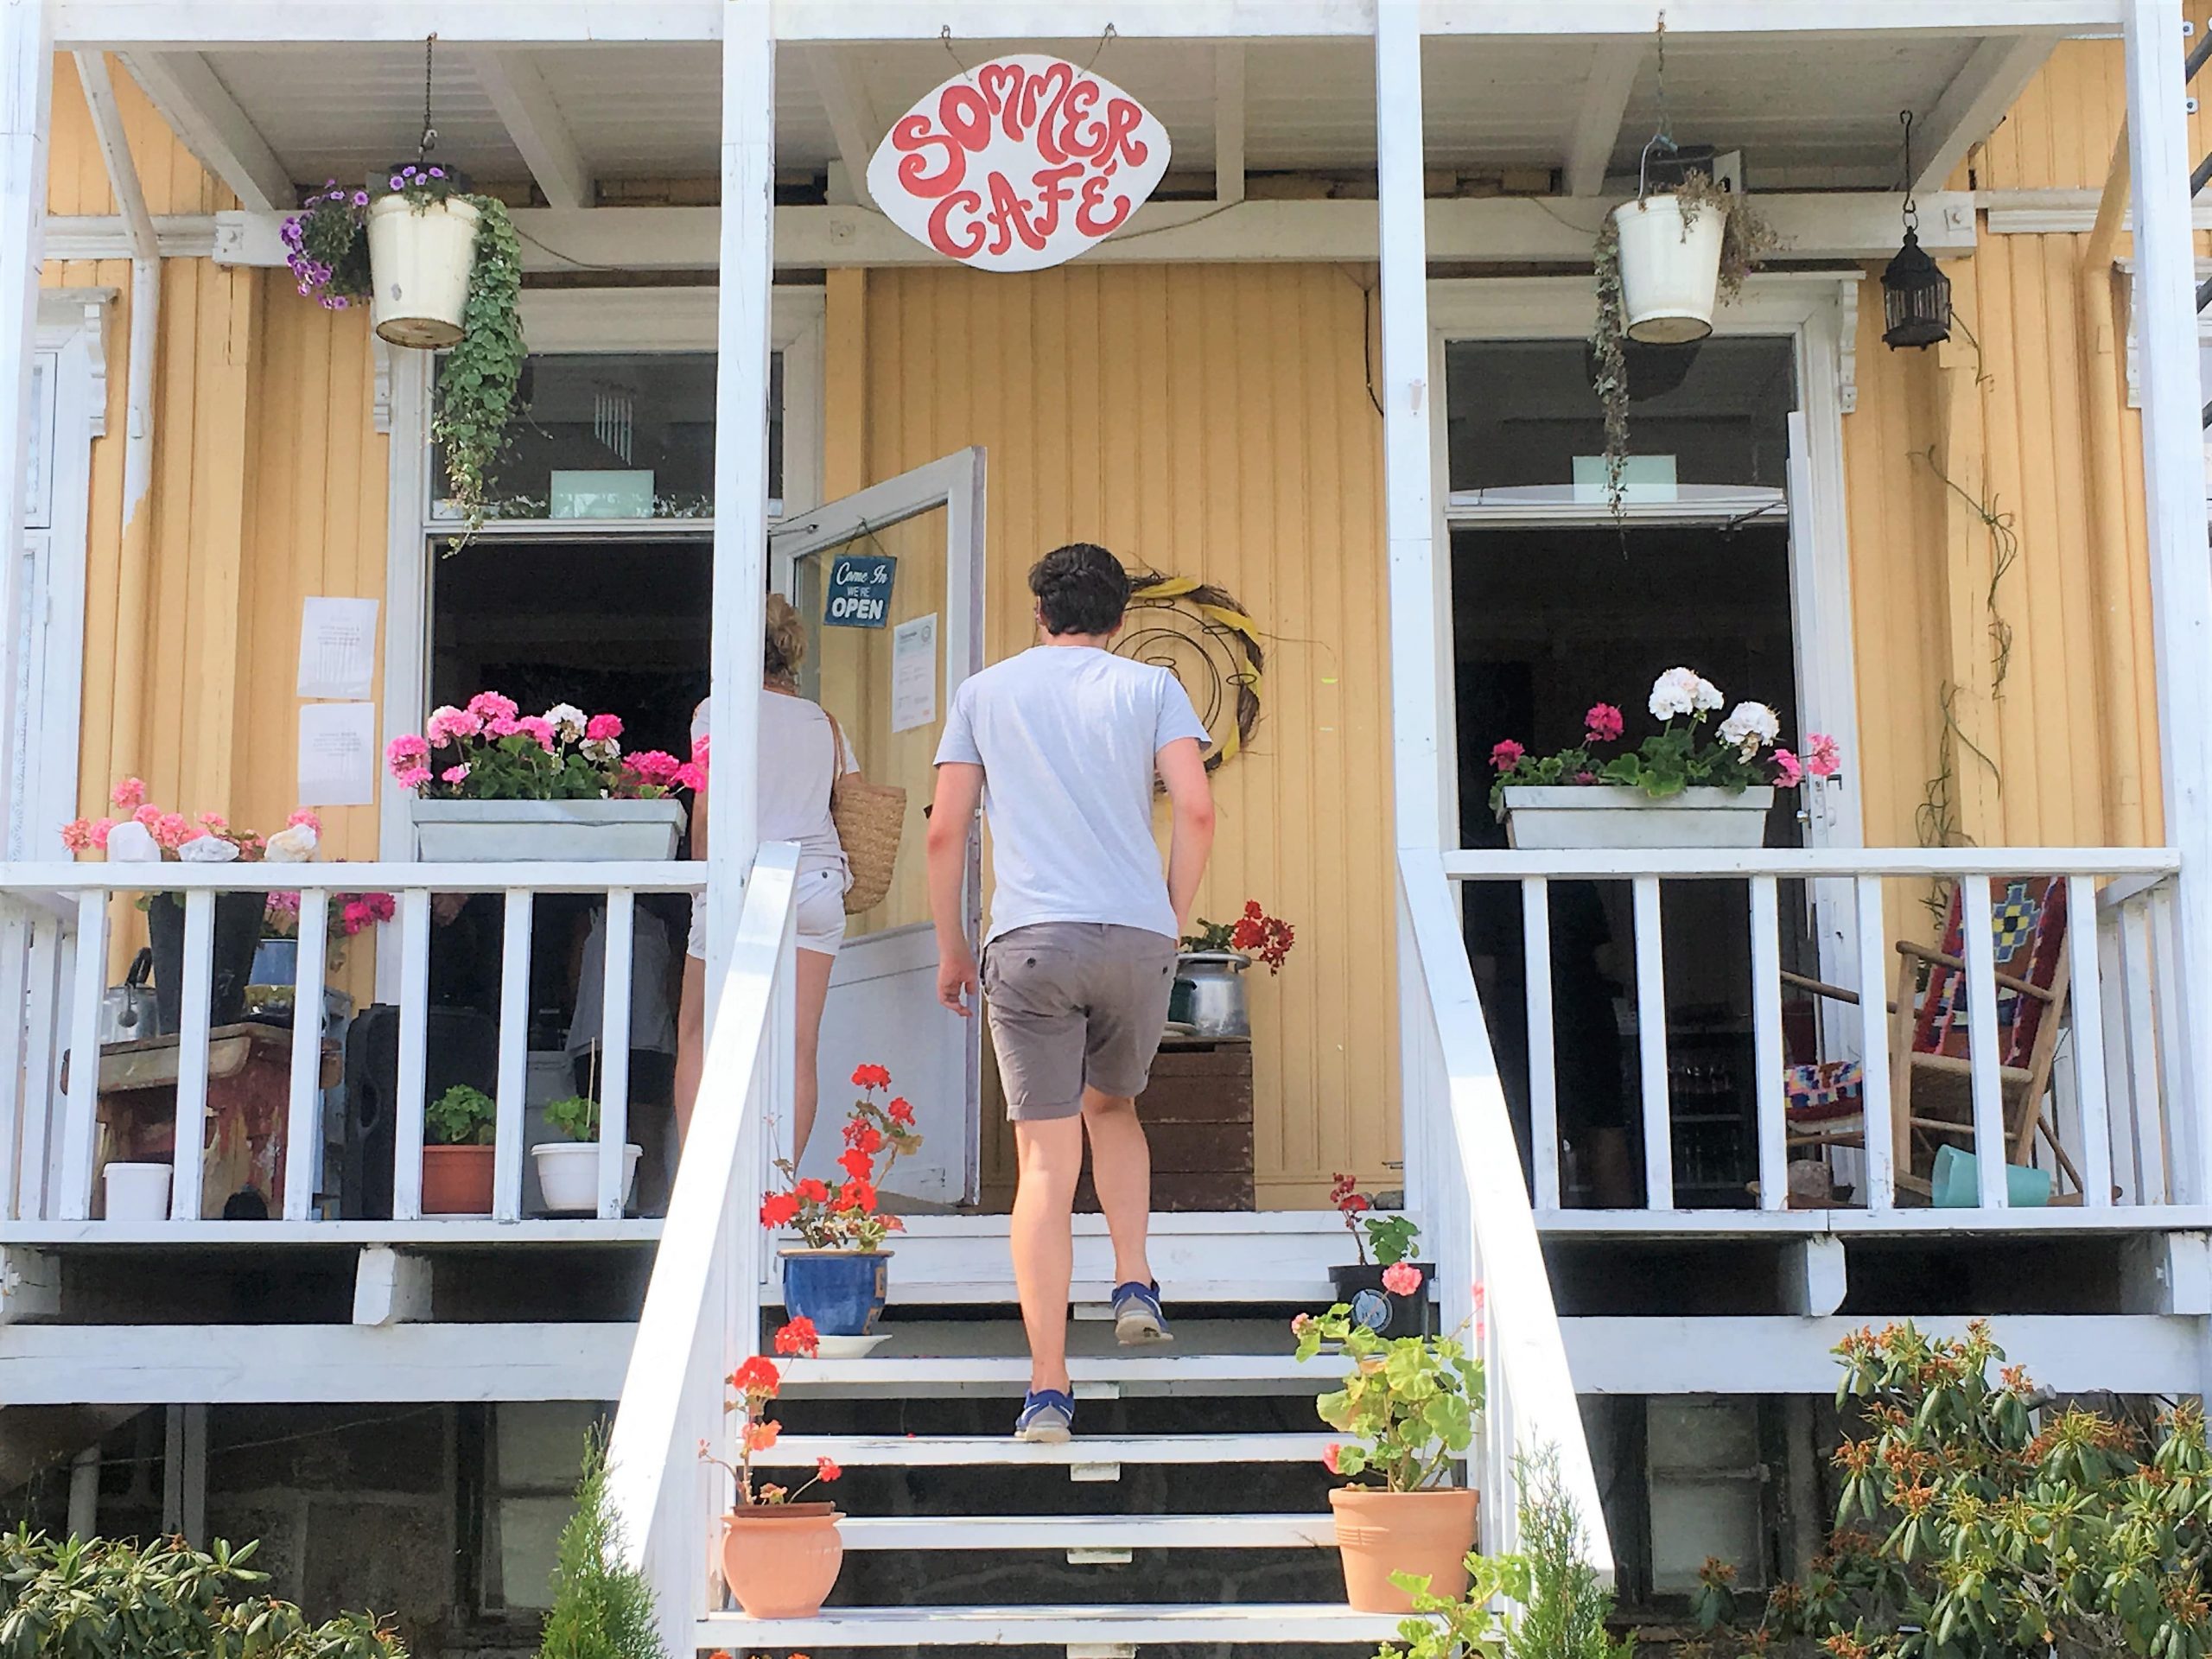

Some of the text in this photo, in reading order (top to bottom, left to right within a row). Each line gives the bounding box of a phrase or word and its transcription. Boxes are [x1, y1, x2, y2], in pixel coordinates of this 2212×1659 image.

[892, 62, 1148, 199] SOMMER
[928, 159, 1131, 259] CAFÉ
[836, 562, 888, 585] Come In
[847, 586, 871, 597] WERE
[831, 597, 884, 620] OPEN
